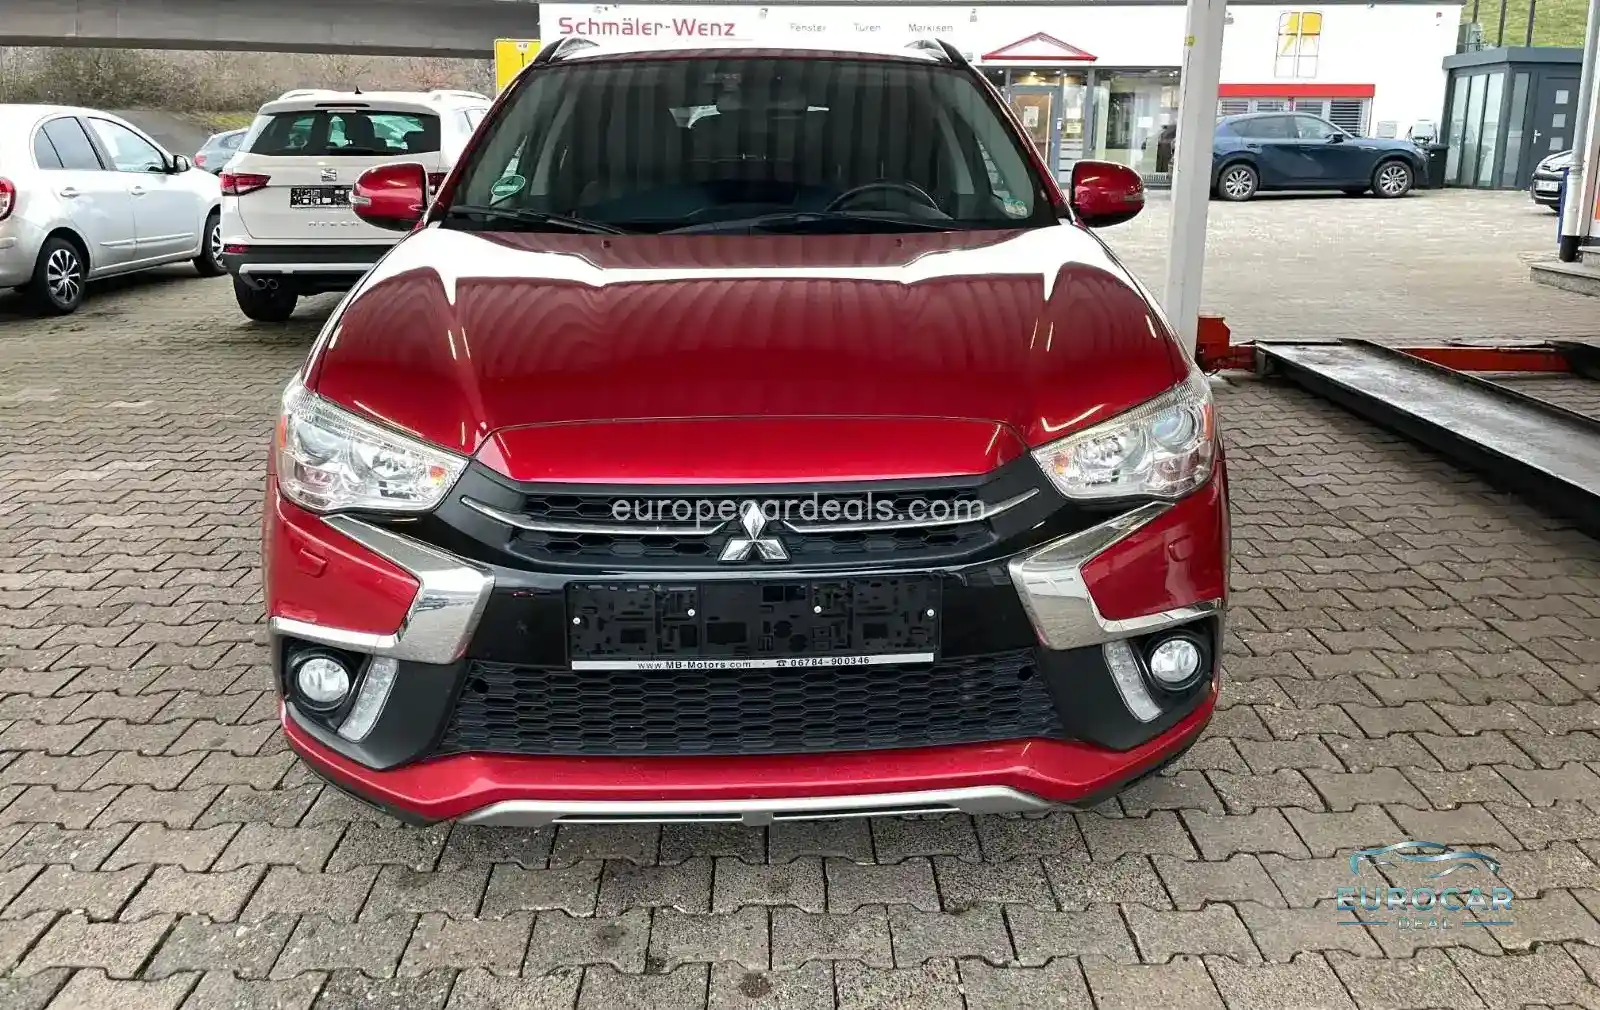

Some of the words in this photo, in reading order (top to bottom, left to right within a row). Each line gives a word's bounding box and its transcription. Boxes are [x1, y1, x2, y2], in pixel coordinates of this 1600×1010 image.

[559, 17, 735, 36] Schmäler-Wenz
[790, 22, 827, 32] Fenster
[908, 23, 954, 33] Markisen
